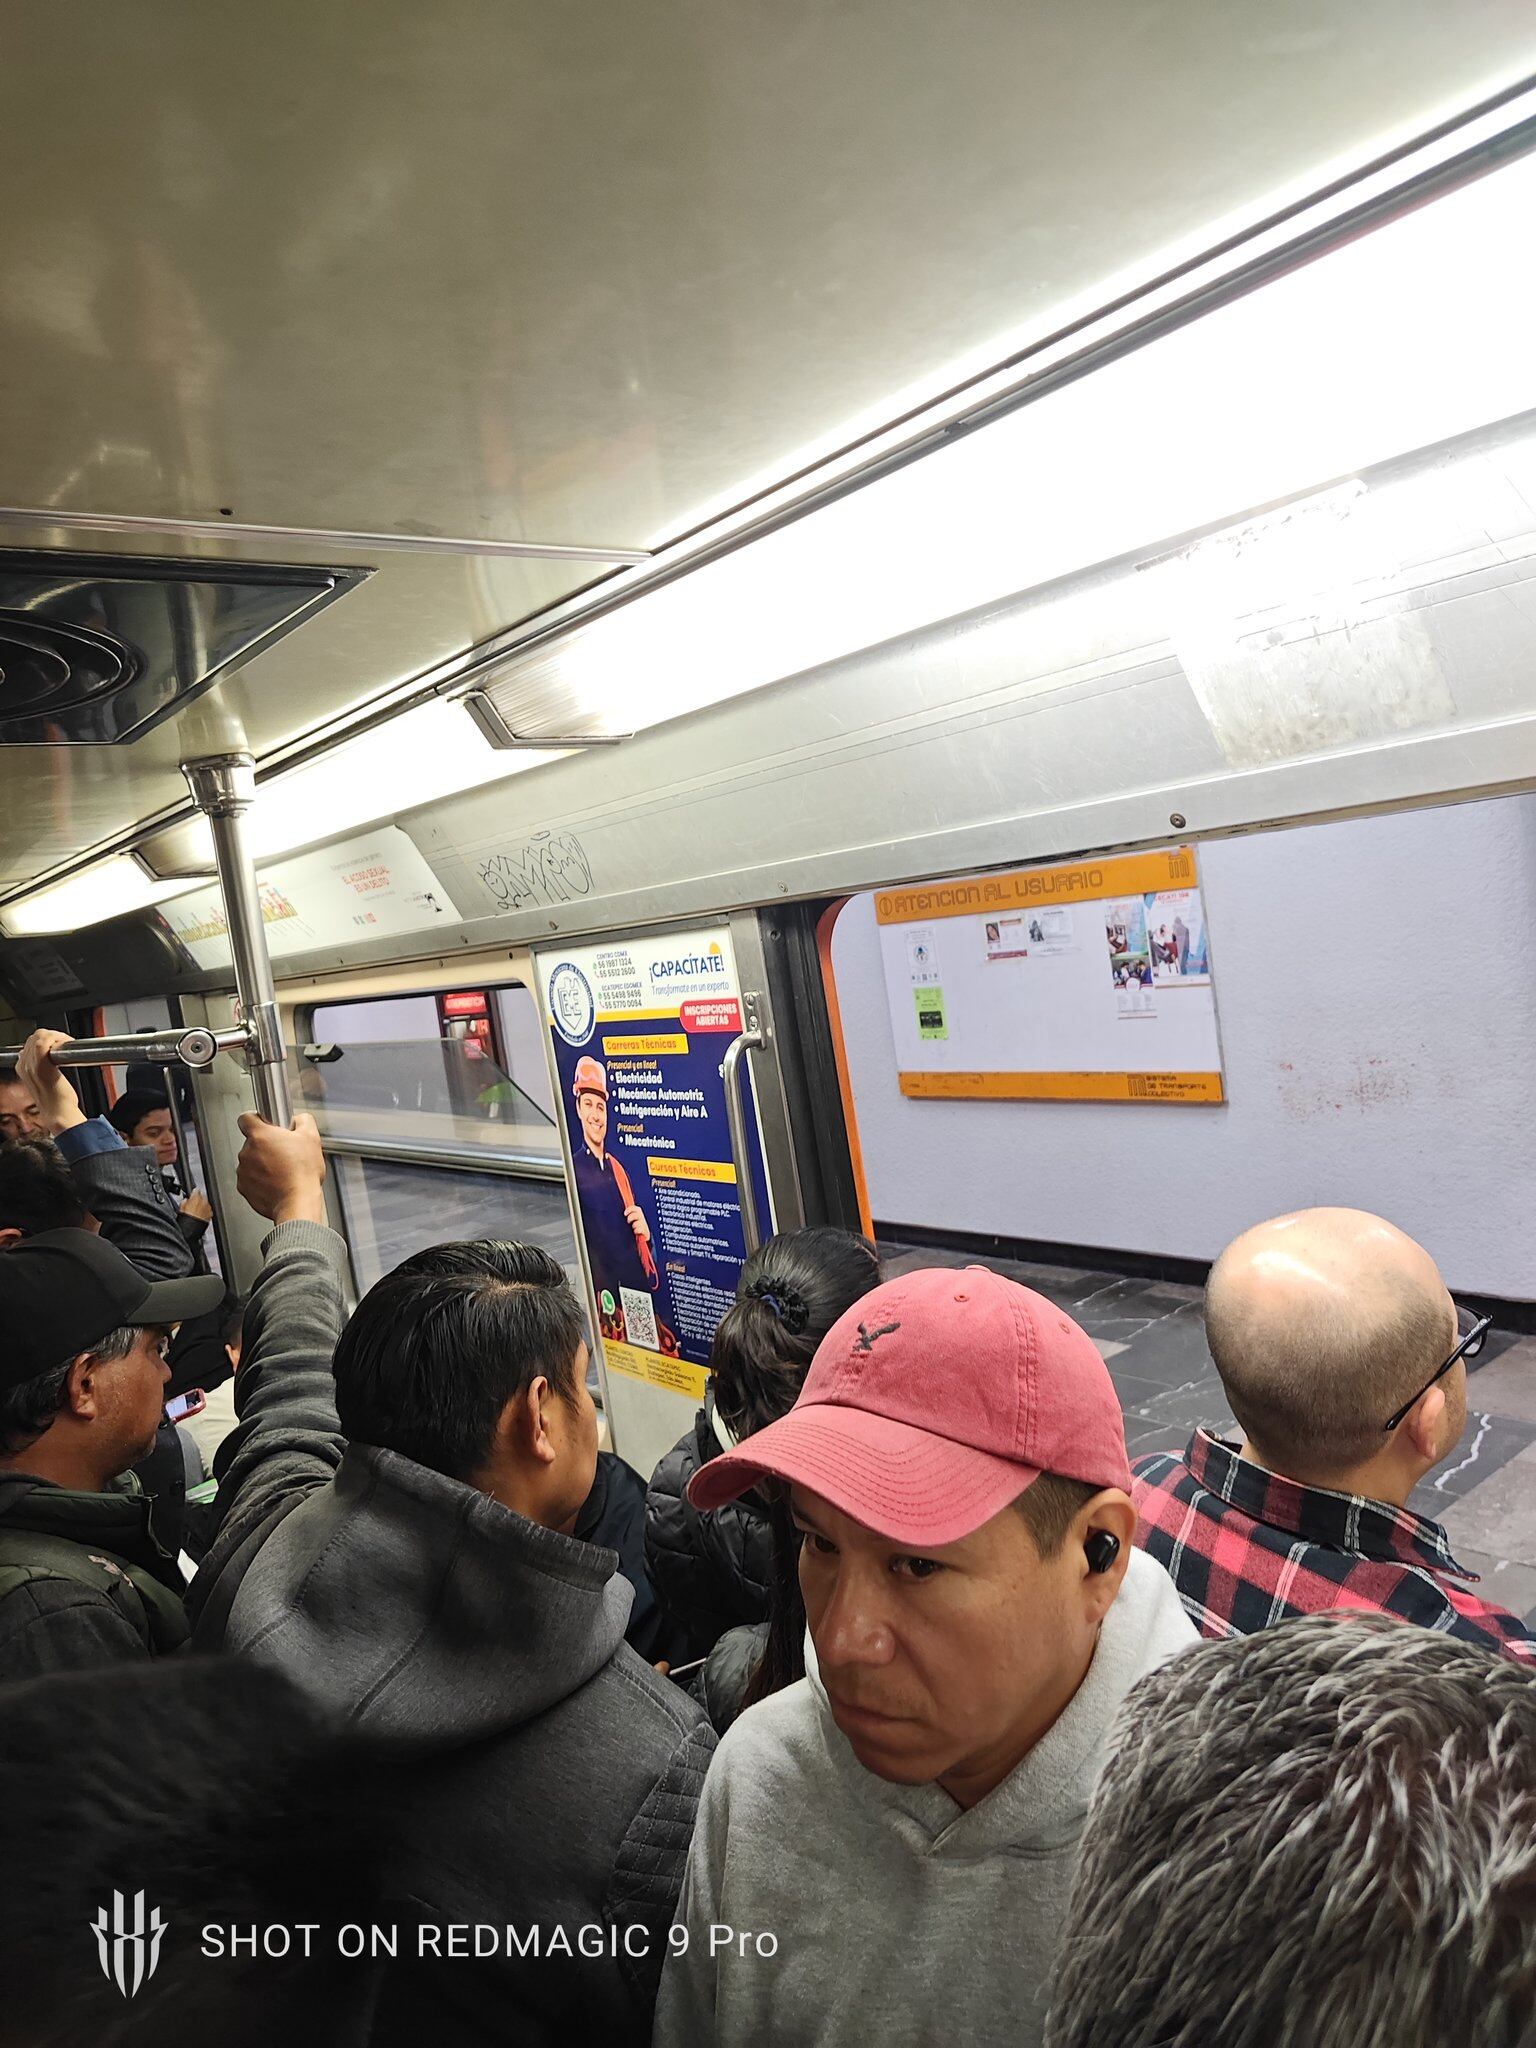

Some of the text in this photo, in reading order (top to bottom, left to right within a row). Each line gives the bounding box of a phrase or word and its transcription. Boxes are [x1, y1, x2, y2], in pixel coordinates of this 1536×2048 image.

[895, 869, 1103, 913] ATENCION AL USUARIO
[649, 952, 725, 982] ¡CAPACÍTATE!
[690, 984, 698, 993] en
[699, 983, 707, 992] un
[707, 980, 729, 993] experto
[684, 1003, 738, 1017] INSCRIPCIONES
[695, 1015, 730, 1026] ABIERTAS
[606, 1038, 677, 1050] Carreras Técnicas
[615, 1070, 662, 1084] Electricidad
[618, 1087, 704, 1101] Mecánica Automotriz
[620, 1102, 673, 1119] Refrigeración
[674, 1106, 680, 1121] y
[681, 1104, 700, 1118] Aire
[625, 1134, 676, 1149] Mecatrónica
[649, 1161, 716, 1177] Cursos Técnicos
[723, 1202, 740, 1211] eléctric
